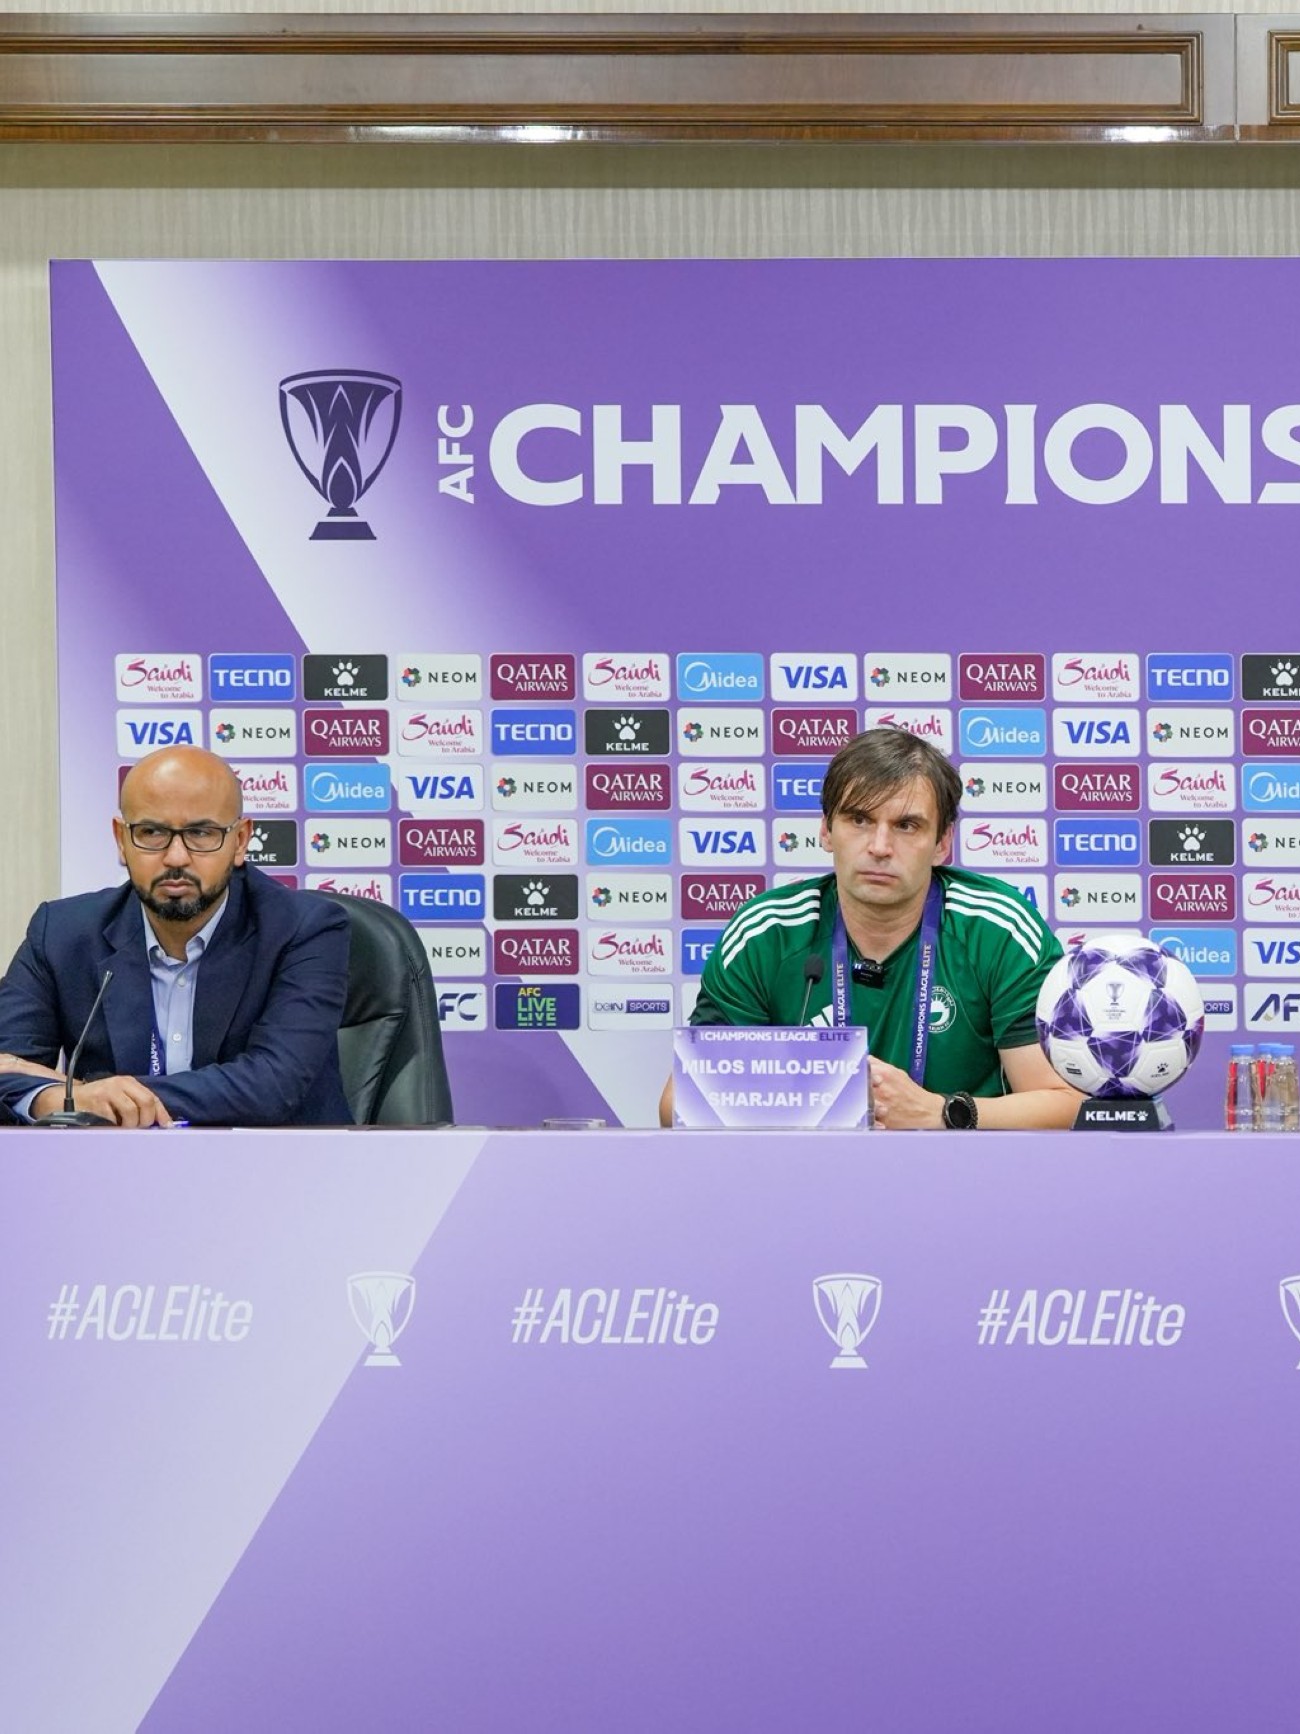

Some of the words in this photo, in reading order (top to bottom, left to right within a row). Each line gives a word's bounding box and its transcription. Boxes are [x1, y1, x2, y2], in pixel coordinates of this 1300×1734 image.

[437, 405, 474, 504] AFC
[214, 668, 292, 686] TECNO
[428, 672, 476, 684] NEOM
[497, 664, 568, 684] QATAR
[684, 662, 758, 692] Midea
[897, 672, 946, 684] NEOM
[966, 664, 1036, 684] QATAR
[1152, 668, 1230, 686] TECNO
[324, 688, 368, 696] KELME
[514, 681, 568, 692] AIRWAYS
[984, 681, 1038, 692] AIRWAYS
[124, 722, 194, 744] VISA
[242, 727, 290, 738] NEOM
[311, 718, 382, 739] QATAR
[496, 724, 574, 742] TECNO
[710, 727, 758, 738] NEOM
[779, 718, 850, 739] QATAR
[966, 716, 1040, 748] Midea
[1060, 720, 1130, 744] VISA
[1180, 727, 1228, 738] NEOM
[328, 736, 382, 747] AIRWAYS
[606, 742, 650, 752] KELME
[796, 736, 850, 747] AIRWAYS
[312, 772, 385, 802] Midea
[404, 776, 474, 798] VISA
[524, 782, 572, 794] NEOM
[776, 778, 821, 796] TEC
[1061, 774, 1132, 794] QATAR
[1078, 791, 1132, 802] AIRWAYS
[406, 828, 476, 849] QATAR
[592, 826, 666, 858] Midea
[686, 830, 756, 854] VISA
[1060, 834, 1138, 852] TECNO
[244, 853, 277, 862] ELME
[424, 846, 478, 857] AIRWAYS
[1170, 852, 1214, 862] KELME
[404, 888, 482, 906] TECNO
[619, 892, 668, 904] NEOM
[687, 883, 757, 903] QATAR
[1088, 892, 1136, 904] NEOM
[432, 947, 480, 958] NEOM
[518, 987, 542, 996] AFC
[439, 993, 478, 1021] FC
[518, 997, 557, 1012] LIVE
[630, 1002, 668, 1012] SPORTS
[1205, 1002, 1230, 1012] ORTS
[705, 1031, 771, 1042] CHAMPIONS
[774, 1031, 817, 1042] LEAGUE
[819, 1032, 850, 1041] ELITE
[682, 1059, 745, 1075] MILOS
[751, 1059, 860, 1075] MILOJEVIC
[708, 1092, 802, 1107] SHARJAH
[809, 1092, 834, 1107] FC
[1085, 1110, 1136, 1121] KELME
[47, 1284, 253, 1341] #ACLElite
[512, 1287, 719, 1346] #ACLElite
[978, 1289, 1185, 1346] #ACLElite
